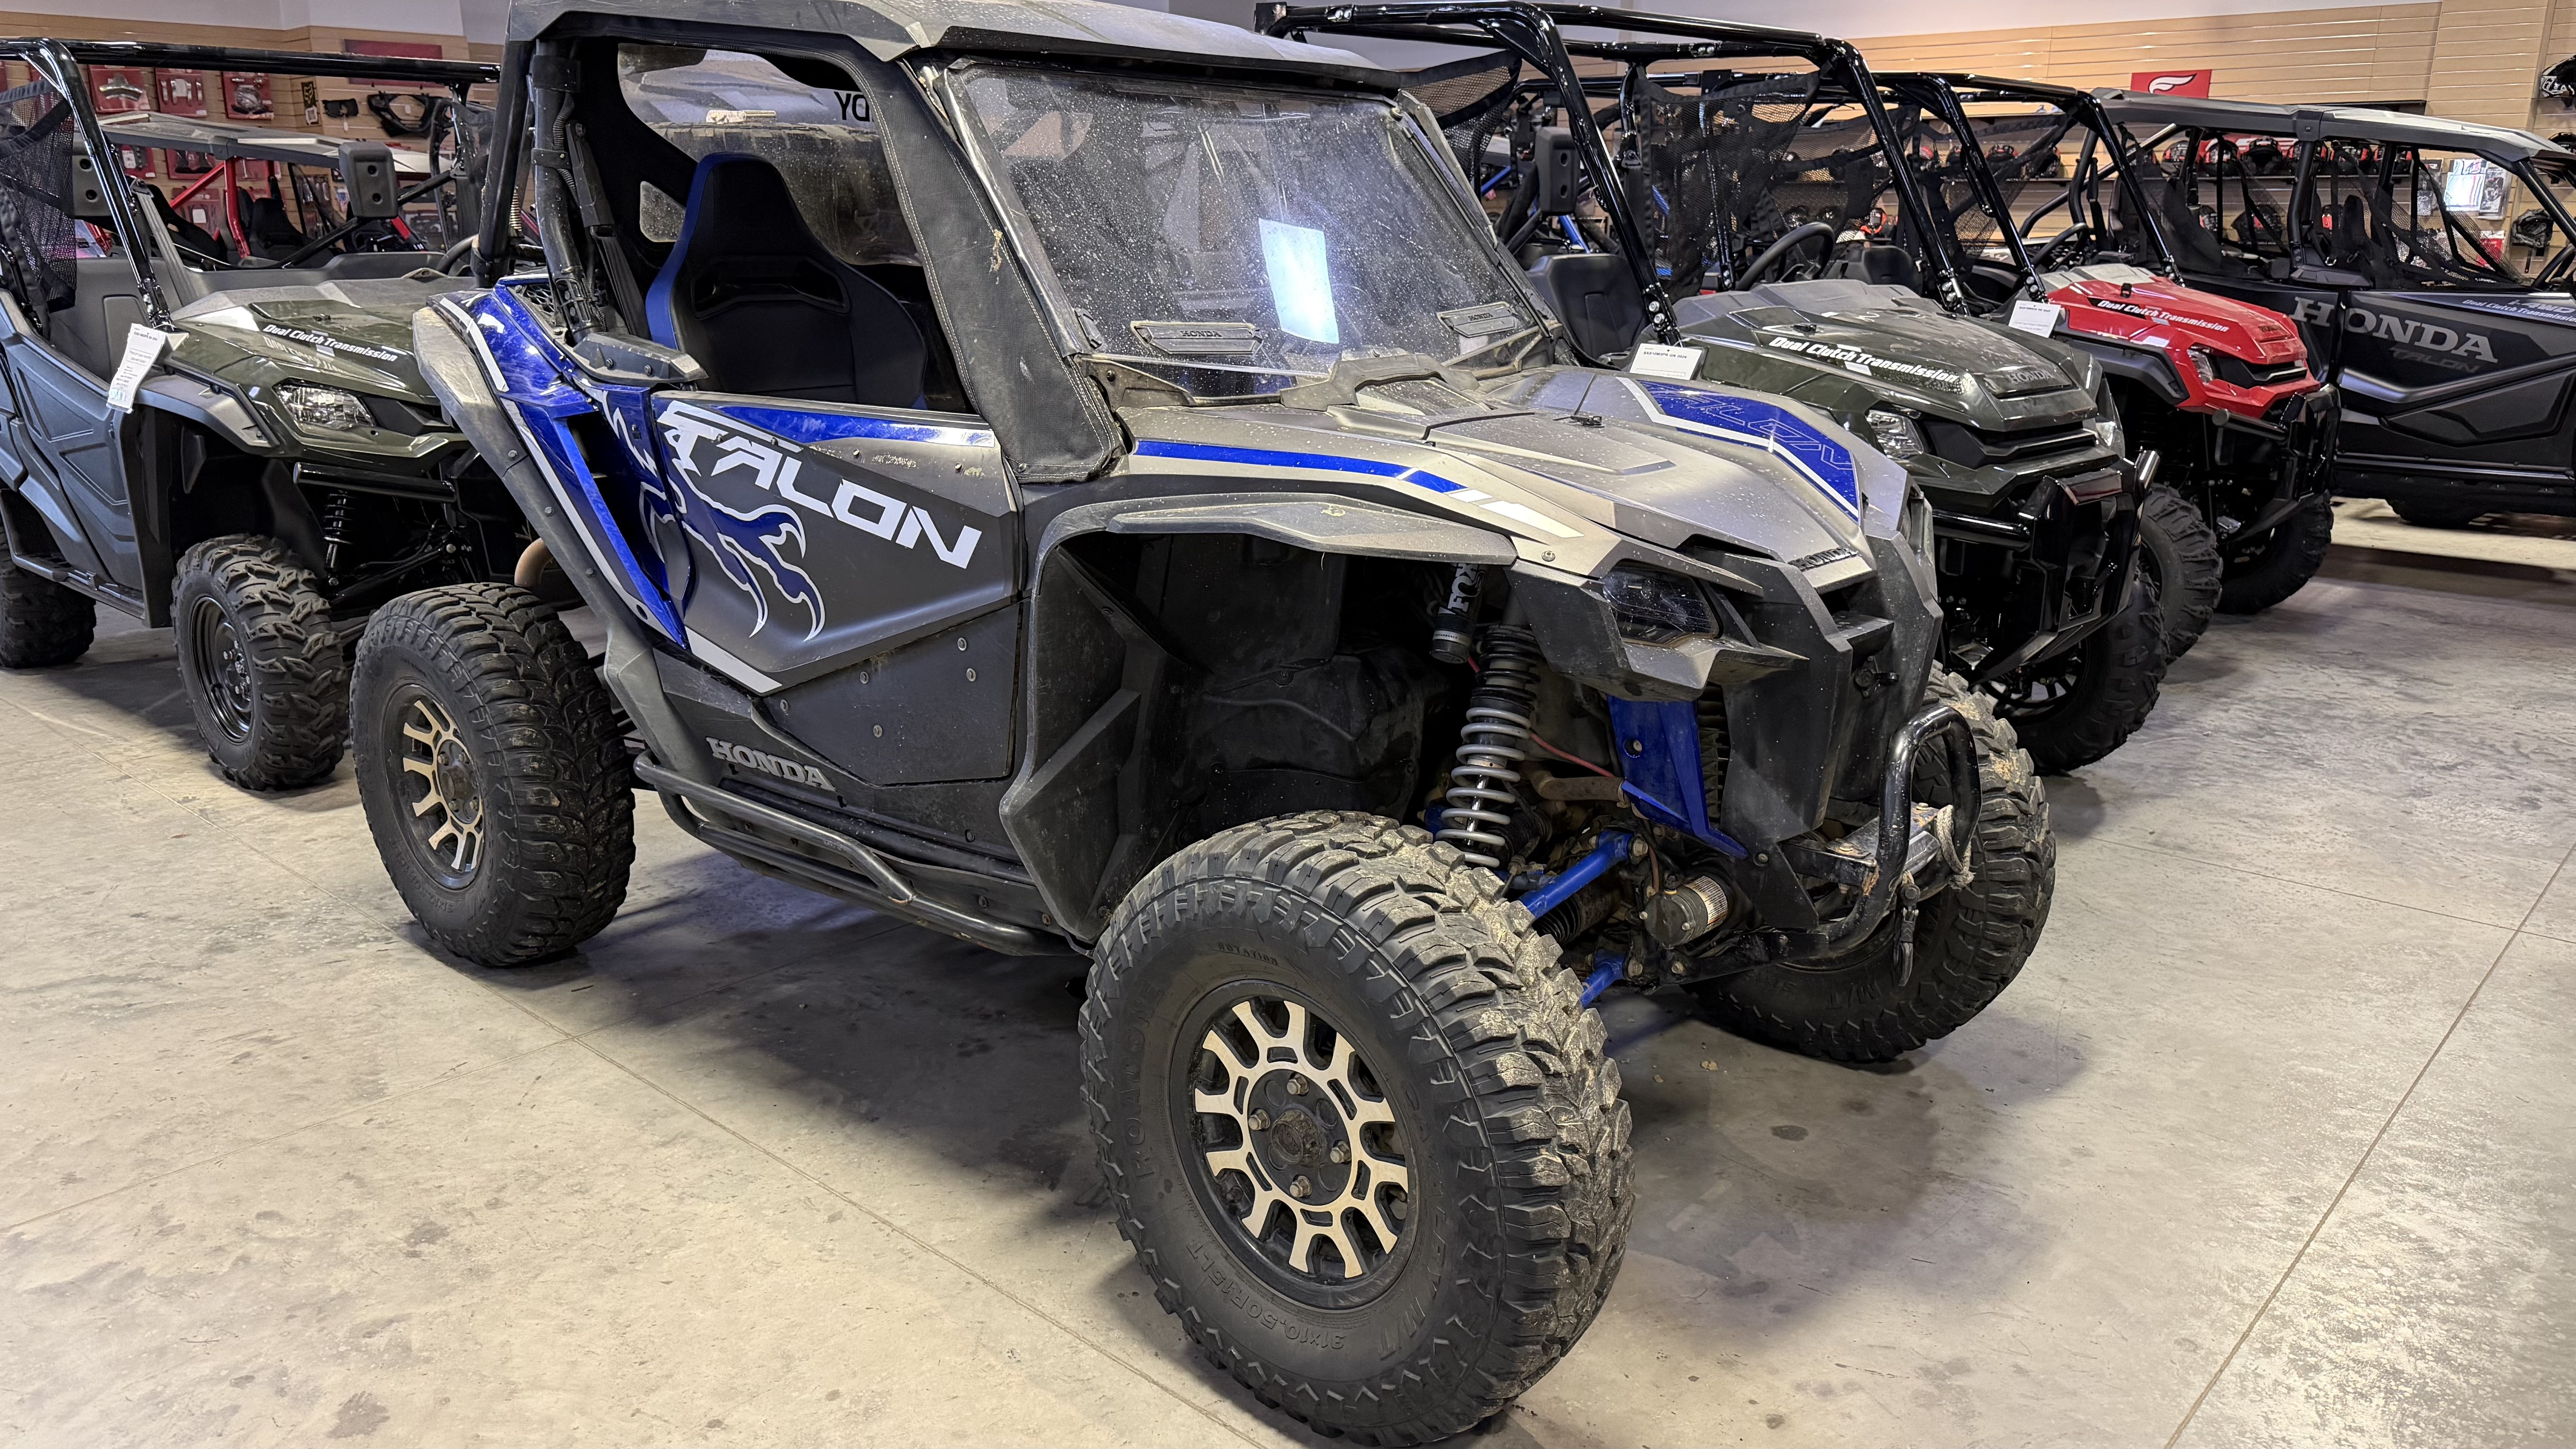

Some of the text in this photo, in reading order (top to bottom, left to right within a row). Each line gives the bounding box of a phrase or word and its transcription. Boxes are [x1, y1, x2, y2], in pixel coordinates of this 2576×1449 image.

[2097, 300, 2229, 333] Dual Clutch Transmission
[2462, 299, 2488, 308] Dual
[2485, 303, 2518, 313] Clutch
[2508, 299, 2576, 313] i-4WD
[263, 324, 398, 361] Dual Clutch Transmission
[2290, 296, 2498, 363] HONDA
[1768, 336, 1960, 382] Dual Clutch Transmission
[2007, 369, 2055, 383] HONDA
[657, 399, 982, 569] TALON
[705, 736, 836, 792] HONDA
[1217, 941, 1278, 966] ROTATION
